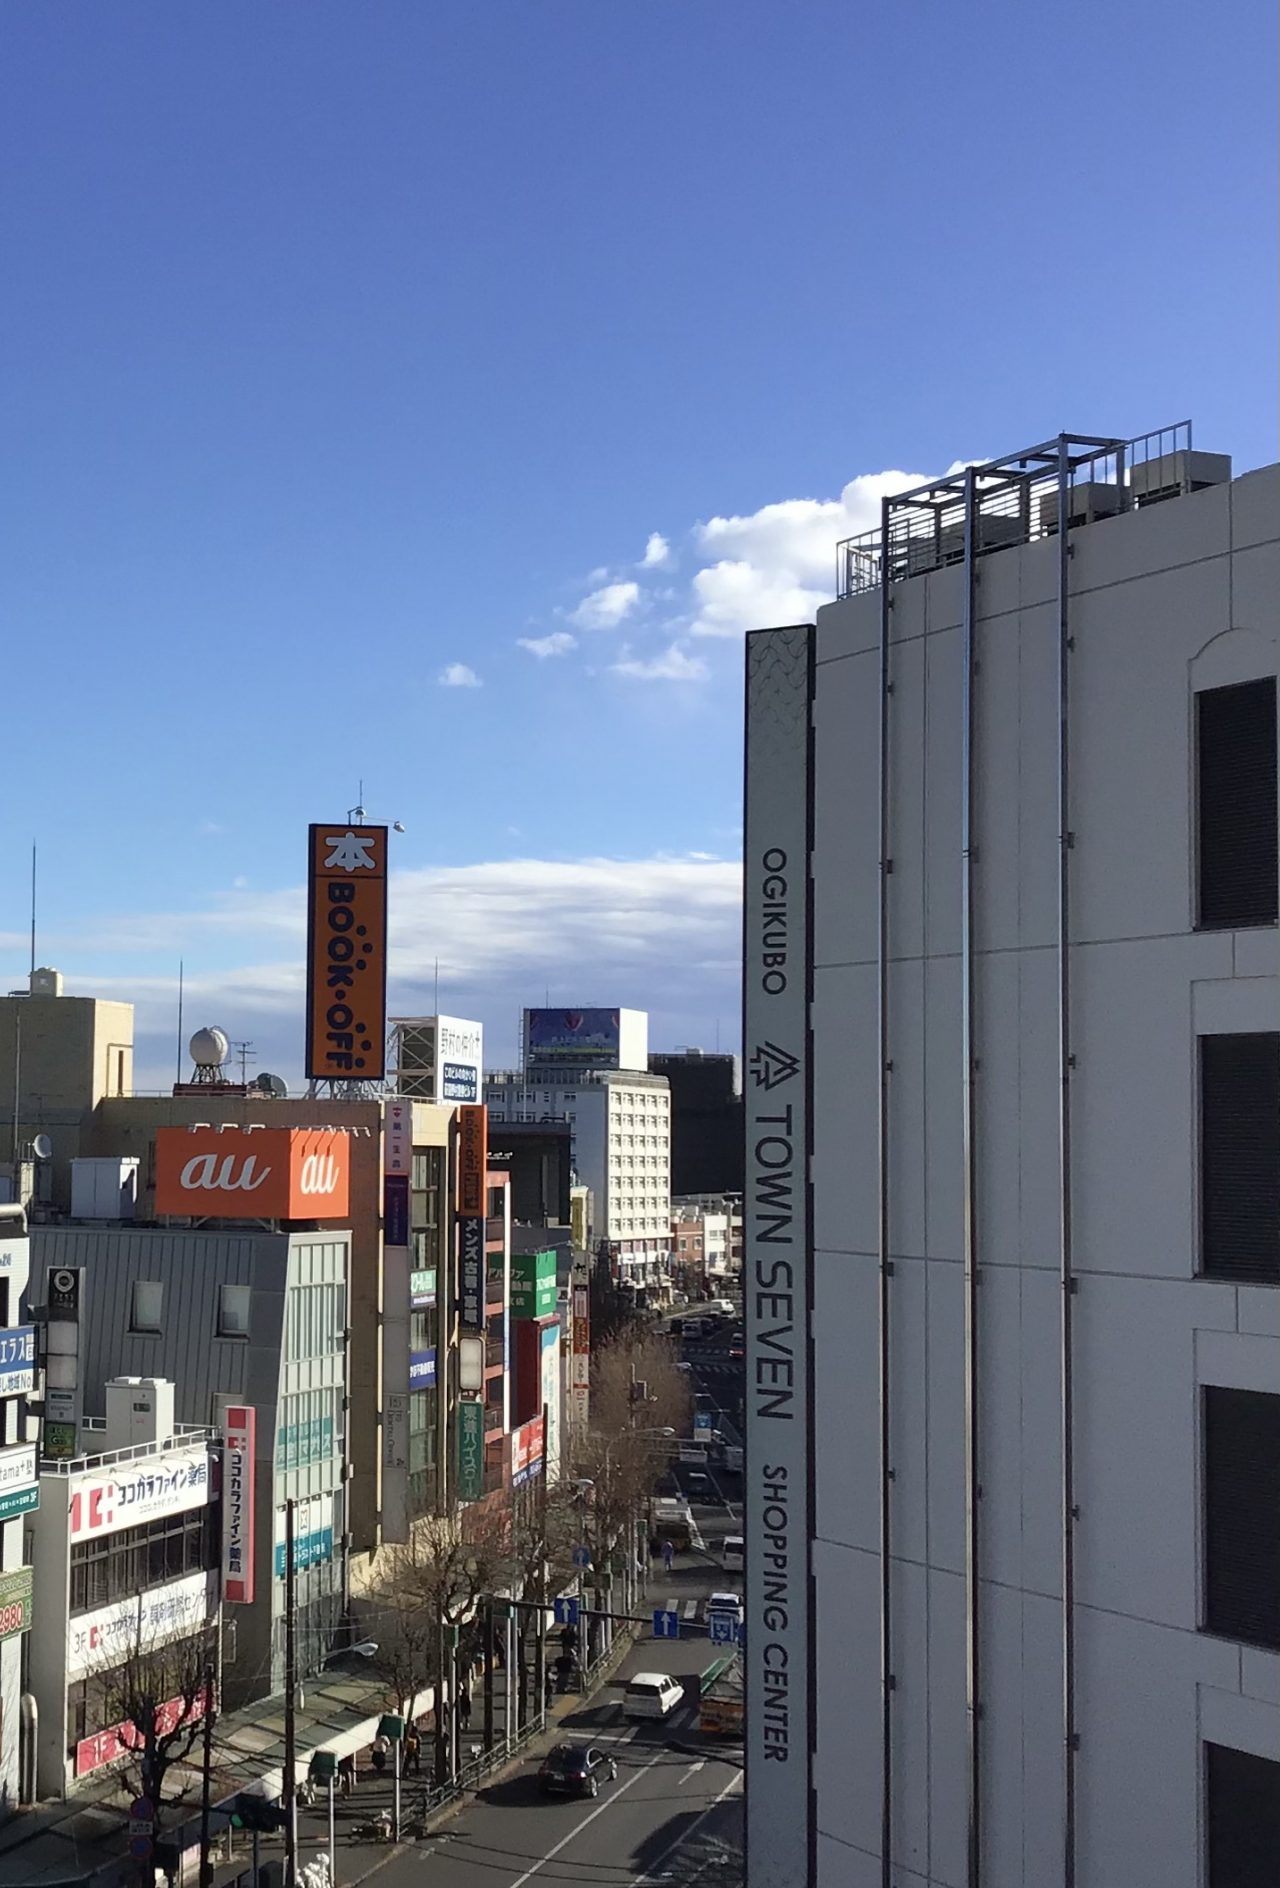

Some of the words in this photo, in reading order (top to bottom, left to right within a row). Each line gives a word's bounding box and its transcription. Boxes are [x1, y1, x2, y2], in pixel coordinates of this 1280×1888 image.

[324, 832, 376, 872] 本
[762, 847, 788, 996] OGIKUBO
[180, 1153, 273, 1191] au
[300, 1153, 341, 1195] au
[755, 1104, 794, 1244] TOWN
[755, 1260, 795, 1420] SEVEN
[228, 1454, 242, 1574] ココカラファイン薬局
[763, 1464, 788, 1632] SHOPPING
[763, 1643, 789, 1763] CENTER
